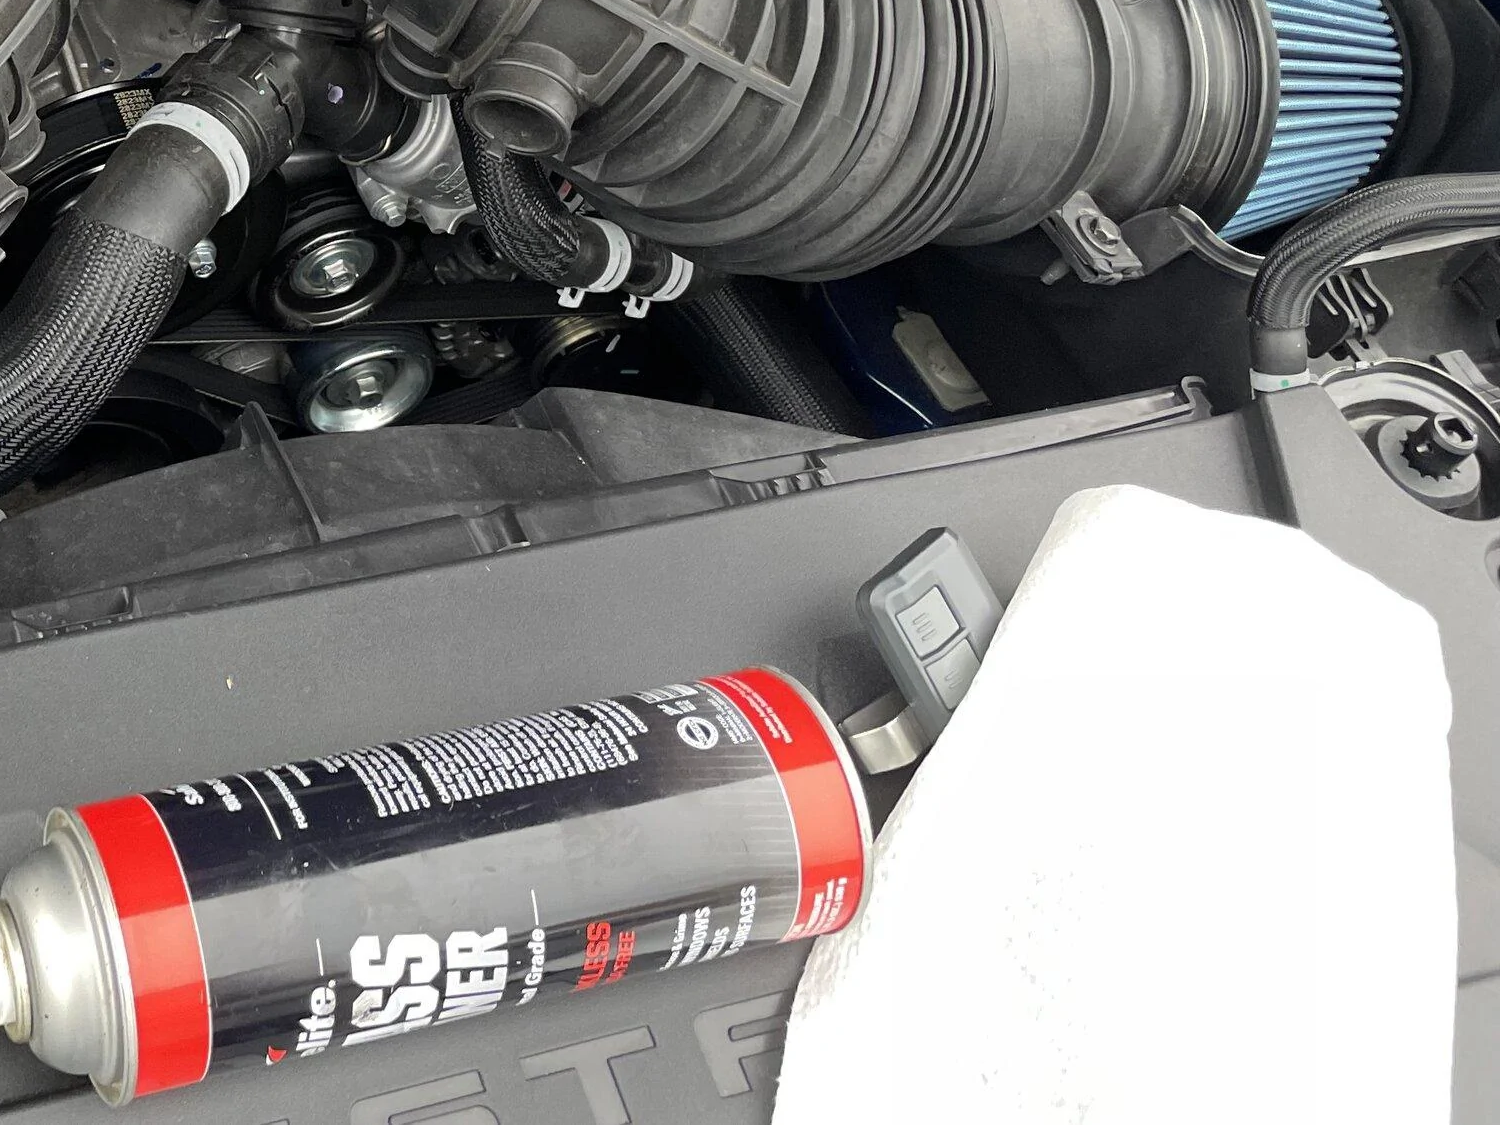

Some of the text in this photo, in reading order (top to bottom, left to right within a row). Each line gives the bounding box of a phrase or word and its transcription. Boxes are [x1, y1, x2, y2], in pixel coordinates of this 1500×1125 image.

[673, 913, 687, 943] Grime
[730, 884, 756, 949] SURFACES
[522, 927, 545, 987] Grade
